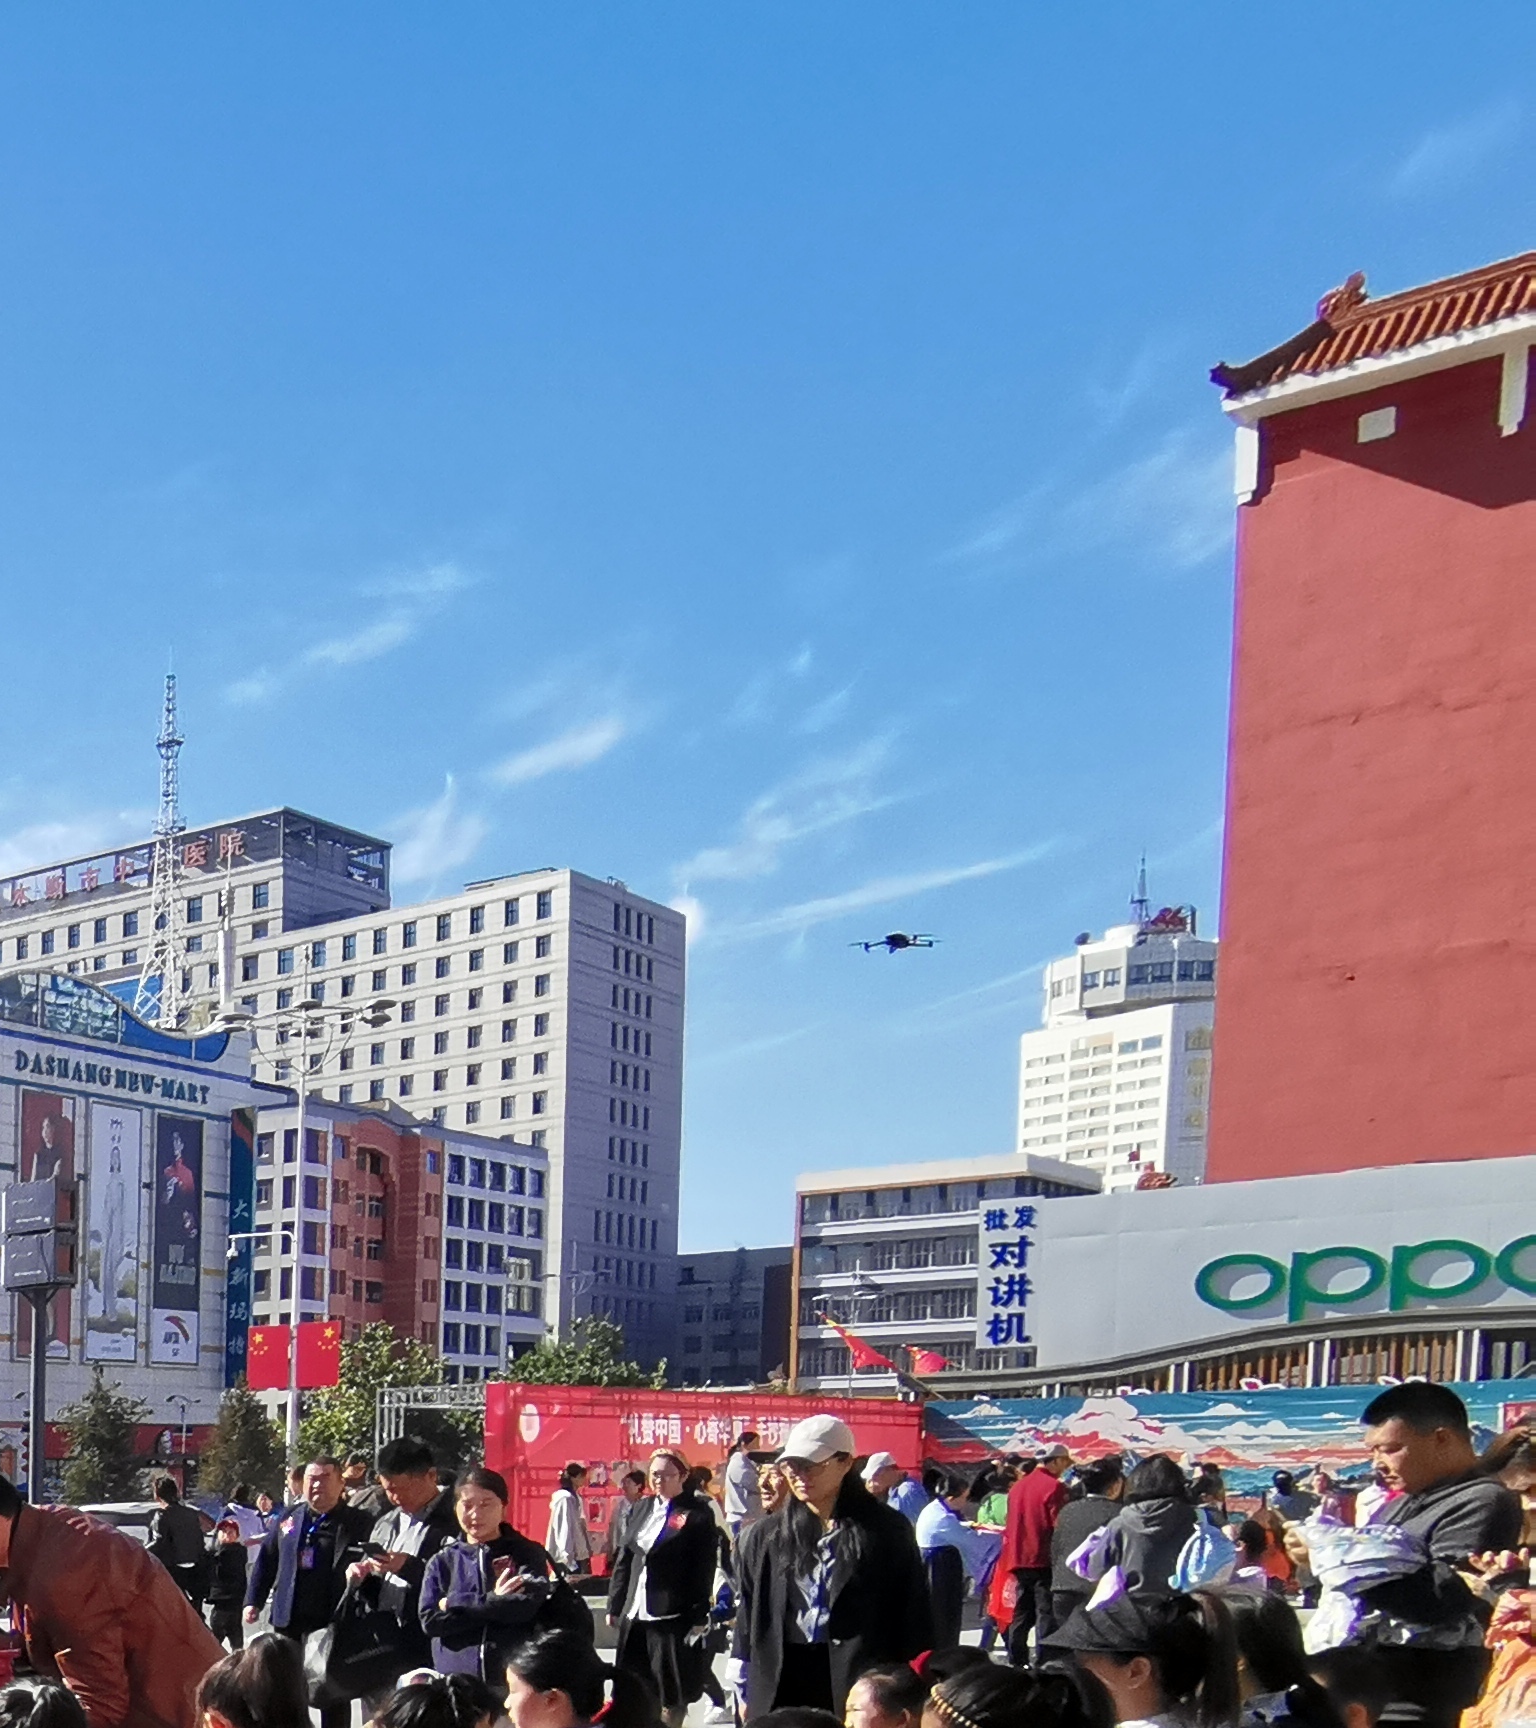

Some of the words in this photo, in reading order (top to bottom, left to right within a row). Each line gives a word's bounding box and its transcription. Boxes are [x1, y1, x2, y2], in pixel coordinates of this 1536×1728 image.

[14, 1049, 113, 1088] DASHANG
[983, 1204, 1038, 1232] 批发
[985, 1236, 1033, 1346] 对讲机
